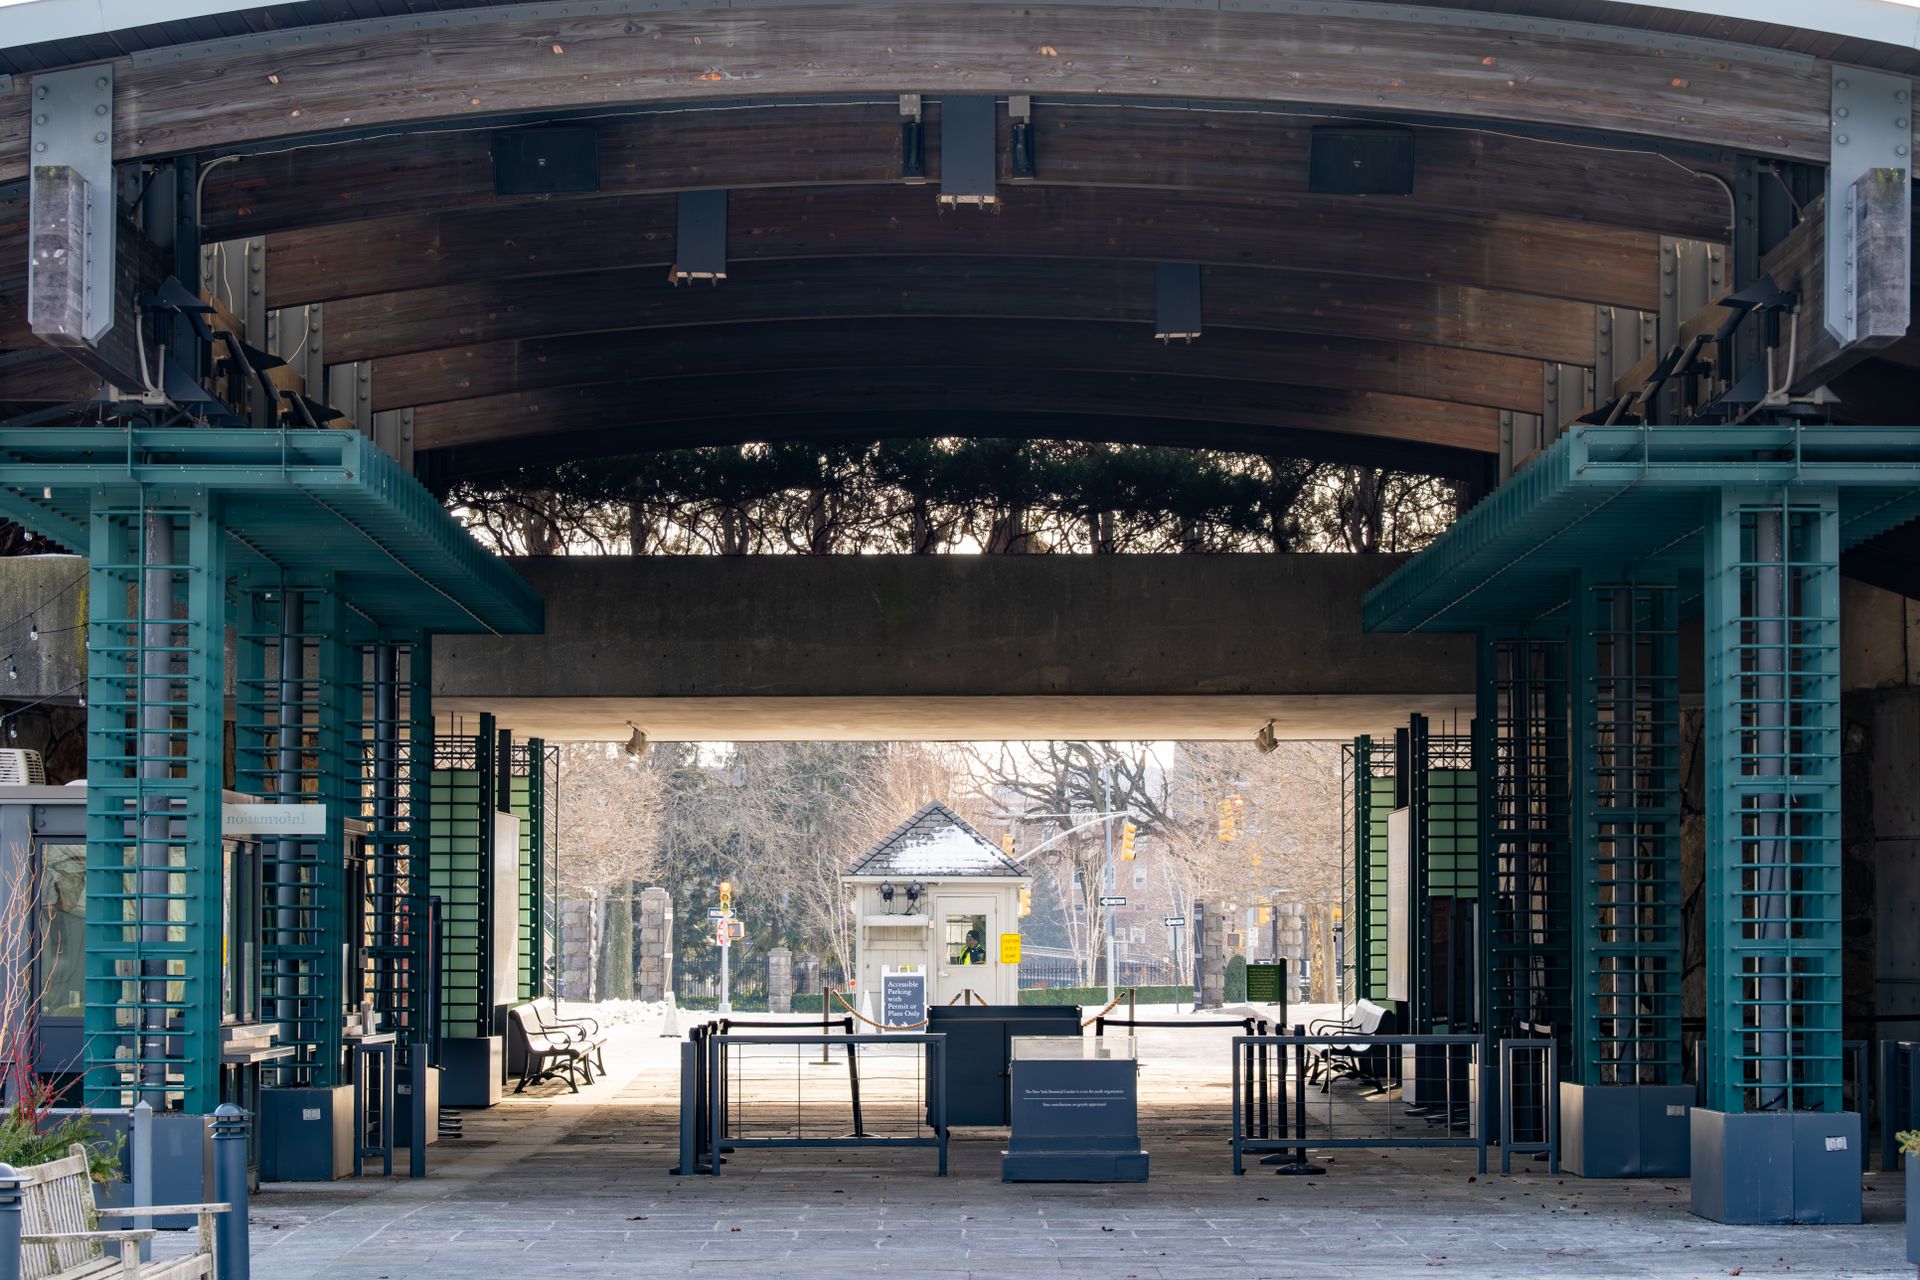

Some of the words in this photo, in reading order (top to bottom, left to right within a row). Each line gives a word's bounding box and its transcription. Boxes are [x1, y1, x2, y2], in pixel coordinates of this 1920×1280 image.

[887, 980, 919, 988] Accessible
[887, 988, 912, 996] Parking
[904, 1010, 920, 1018] Only
